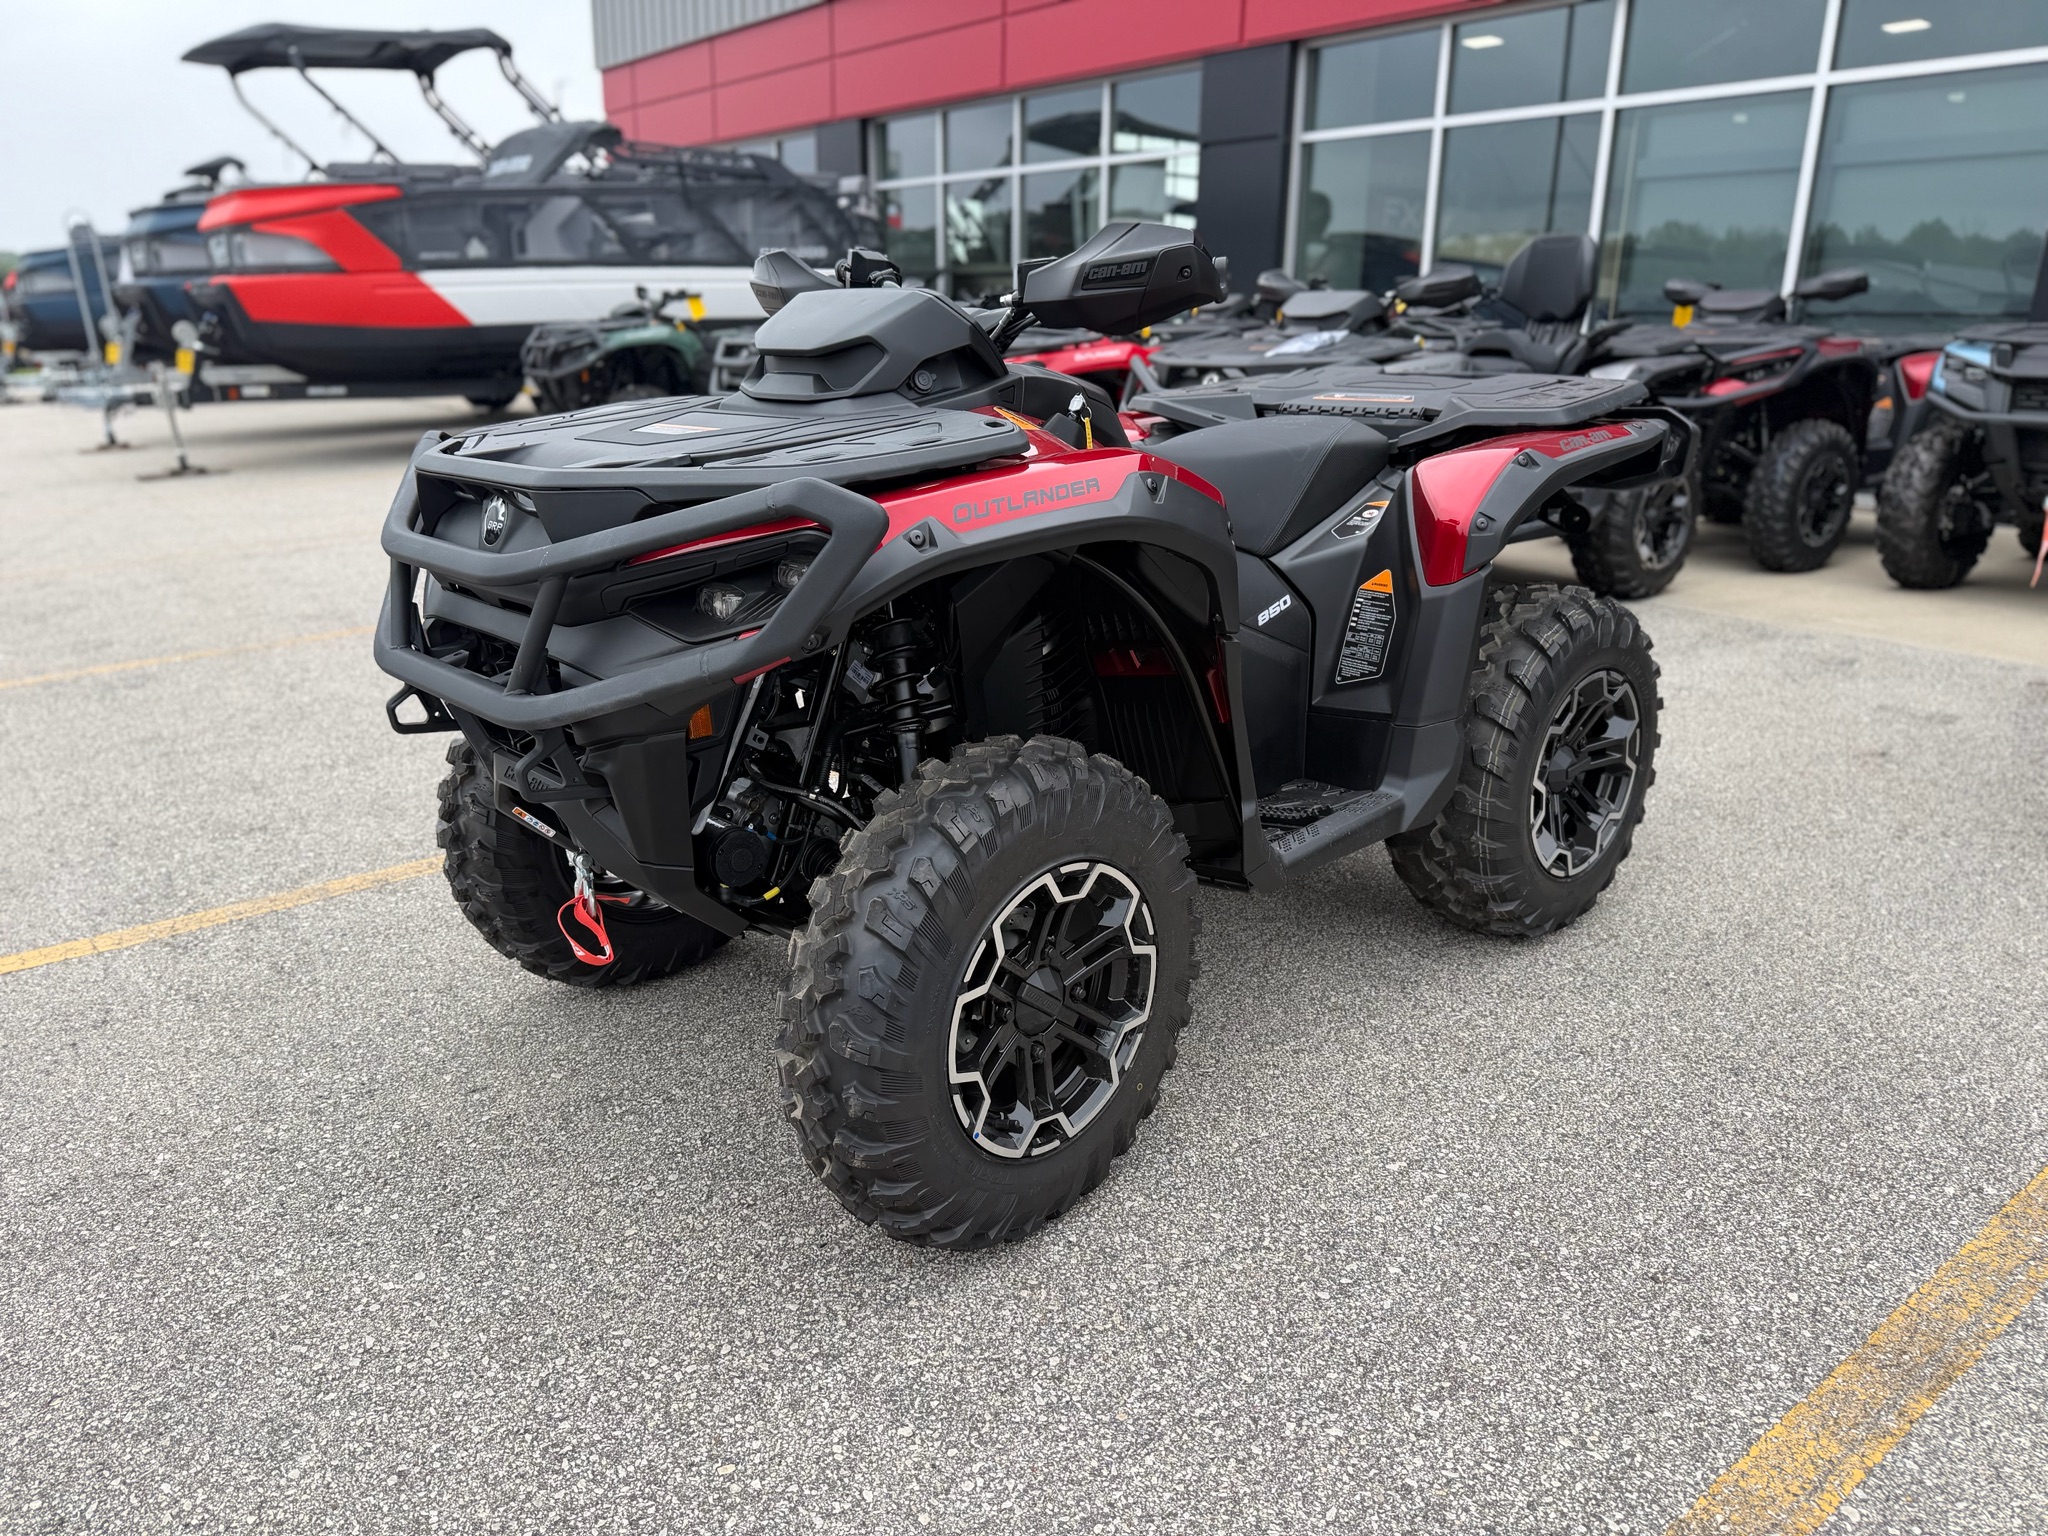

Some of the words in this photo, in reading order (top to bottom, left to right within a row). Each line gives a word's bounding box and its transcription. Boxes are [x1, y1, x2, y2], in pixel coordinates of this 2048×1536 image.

[1088, 261, 1148, 279] can-am
[1559, 430, 1613, 451] can-am
[953, 477, 1100, 524] OUTLANDER
[487, 520, 503, 530] BRP
[1257, 594, 1292, 626] 850
